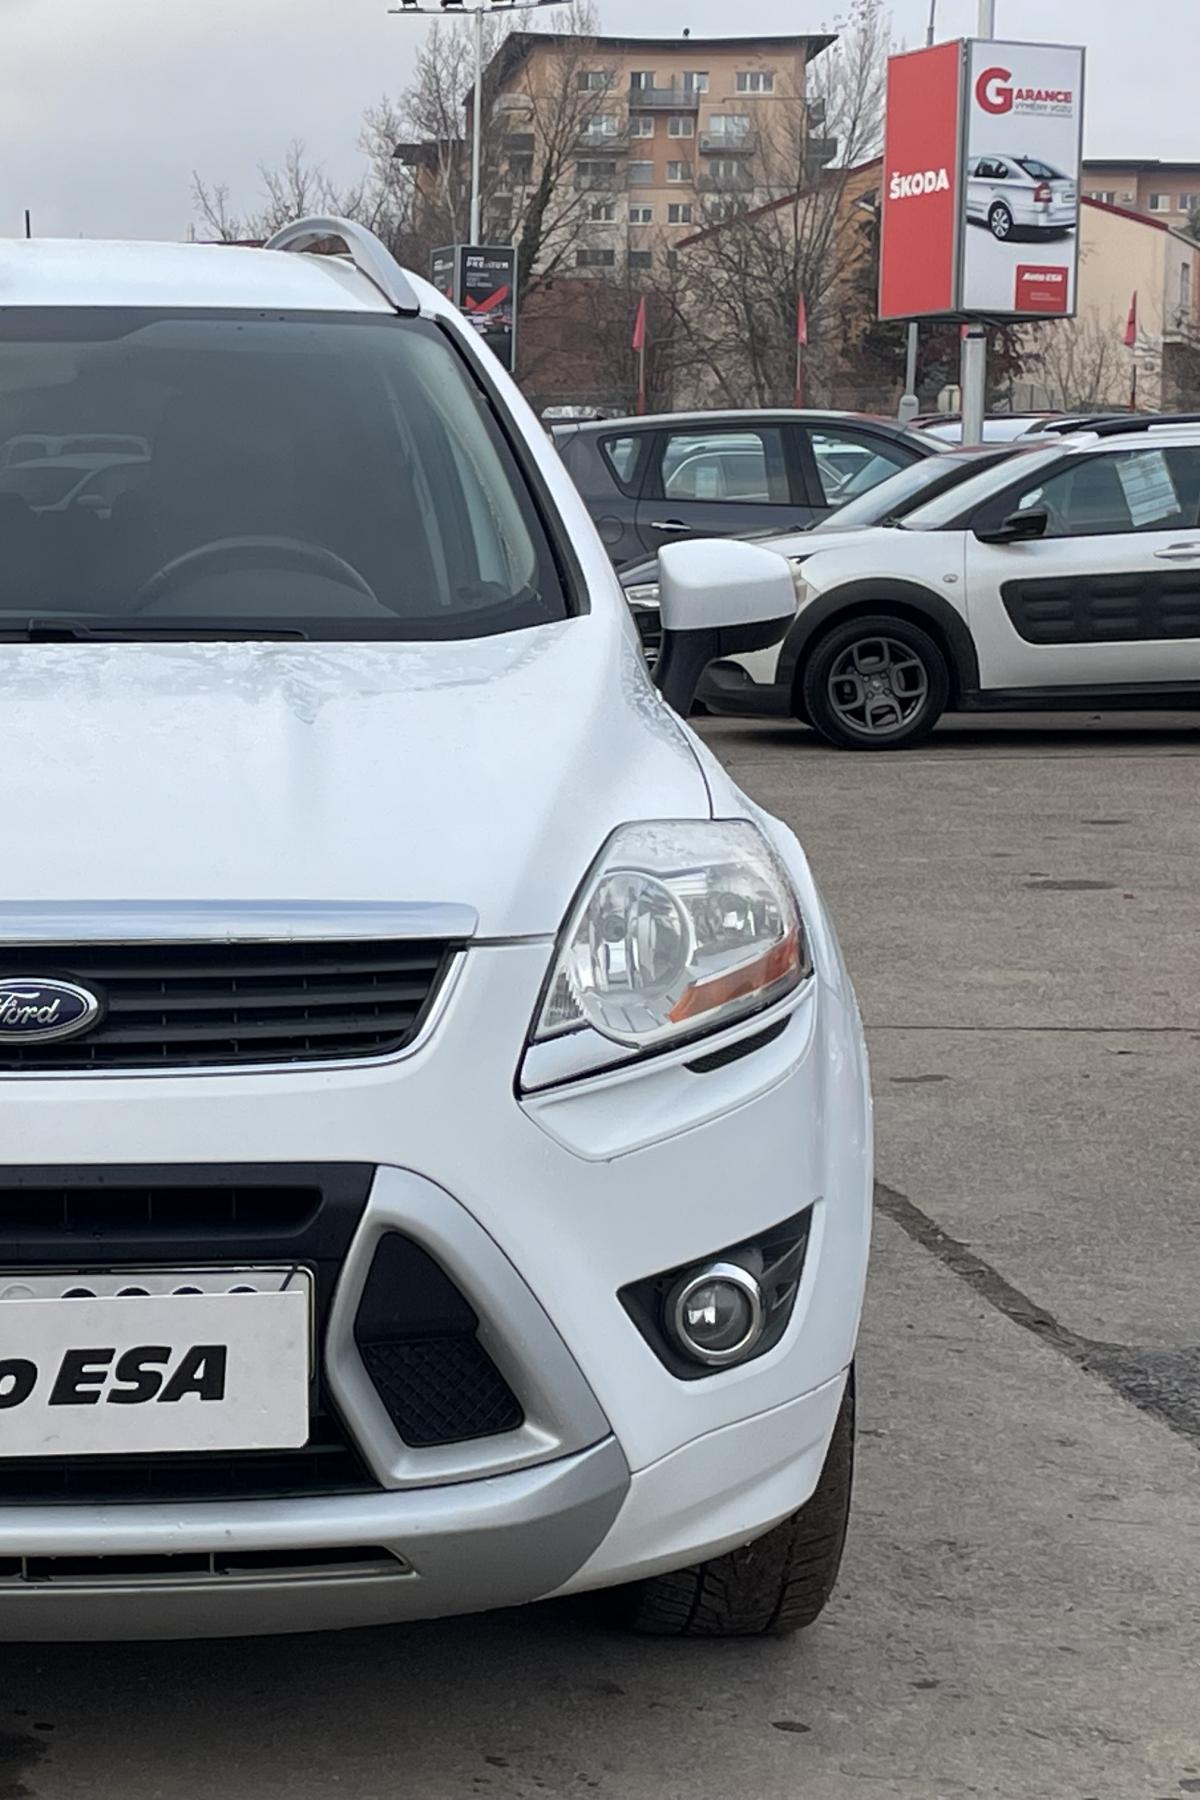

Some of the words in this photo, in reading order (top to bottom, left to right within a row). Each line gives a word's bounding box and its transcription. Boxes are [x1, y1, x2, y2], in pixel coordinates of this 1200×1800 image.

[975, 66, 1072, 115] GARANCE
[889, 168, 950, 199] ŠKODA
[48, 1344, 228, 1406] ESA
